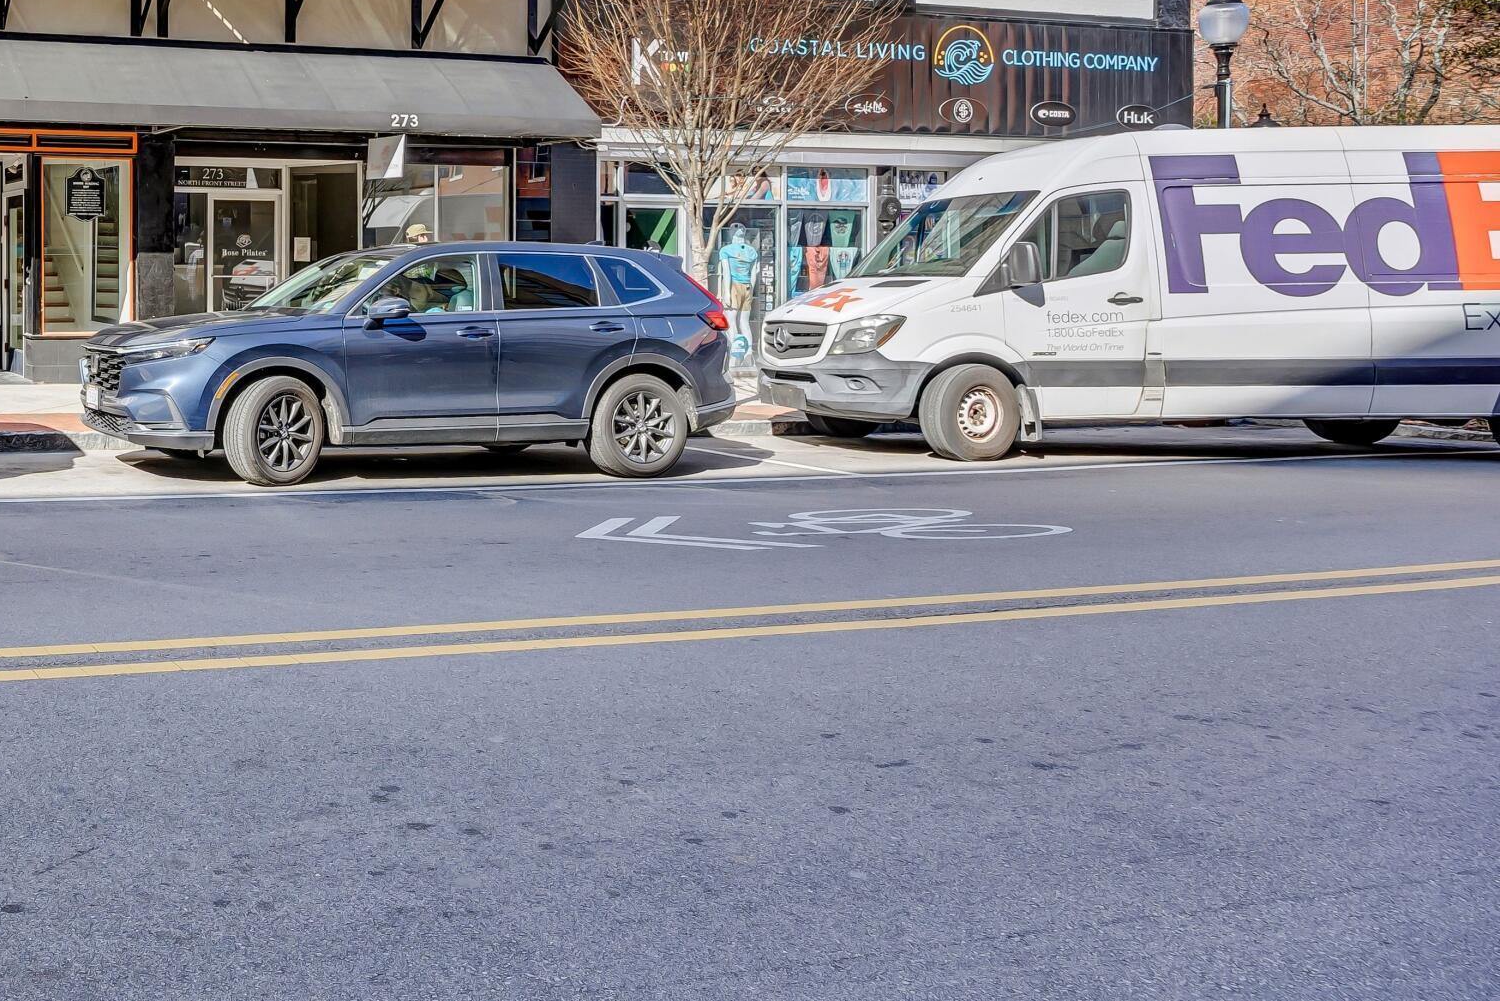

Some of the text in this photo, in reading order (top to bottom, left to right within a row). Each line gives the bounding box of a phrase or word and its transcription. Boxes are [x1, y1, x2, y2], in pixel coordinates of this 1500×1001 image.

[857, 42, 926, 61] LIVING
[1002, 49, 1158, 72] CLOTHING COMPANY
[1049, 110, 1070, 118] COSTA
[391, 114, 419, 127] 273
[202, 168, 224, 180] 273
[950, 304, 982, 313] 254641
[1047, 310, 1124, 324] fedex.com
[1047, 327, 1124, 338] 1.800.GoFedEx
[1047, 342, 1124, 351] The World On Time
